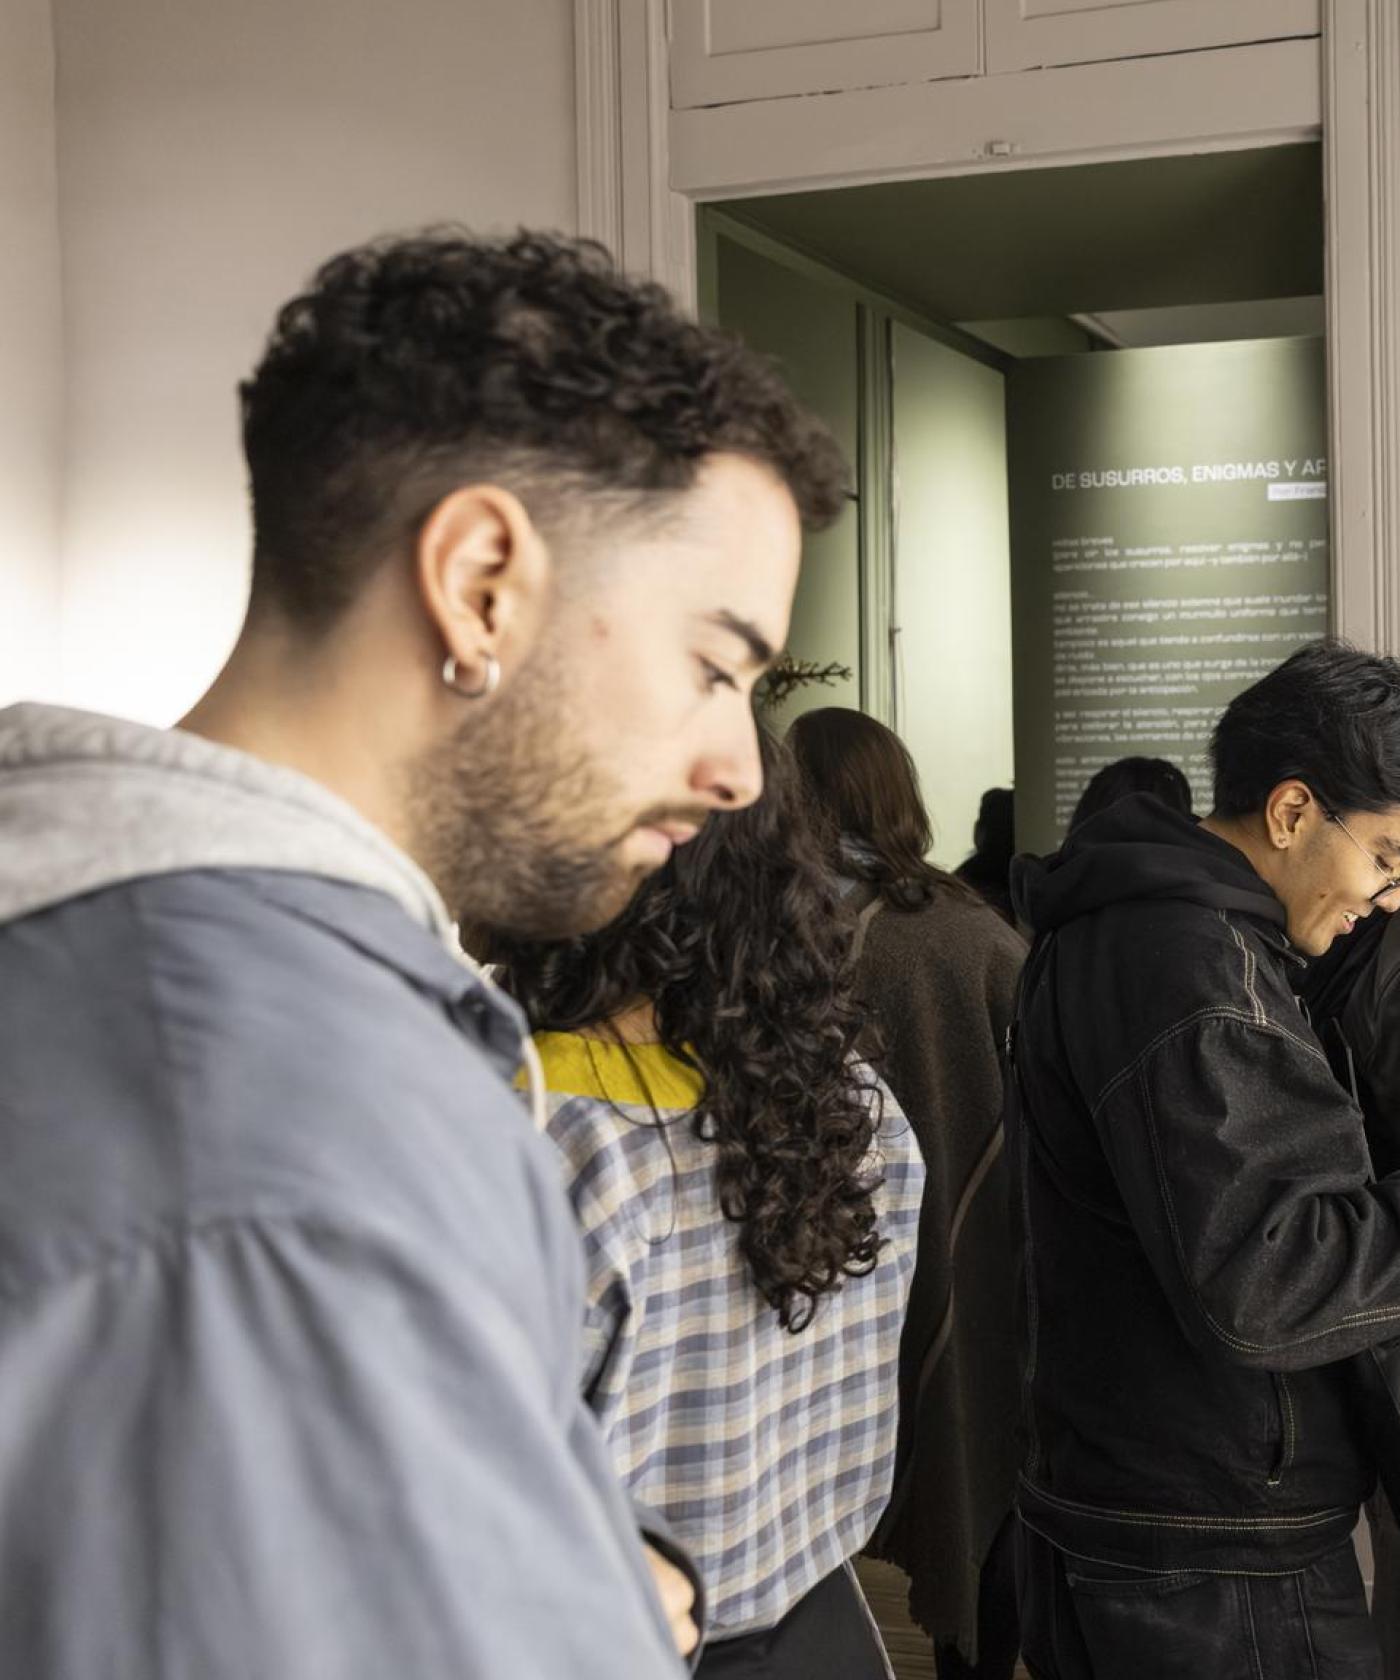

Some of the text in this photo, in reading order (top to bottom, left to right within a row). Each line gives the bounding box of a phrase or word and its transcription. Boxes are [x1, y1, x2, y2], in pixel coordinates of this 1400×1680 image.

[1052, 473, 1077, 490] DE
[1079, 467, 1188, 489] SUSURROS,
[1192, 460, 1280, 483] ENIGMAS
[1284, 459, 1297, 477] Y
